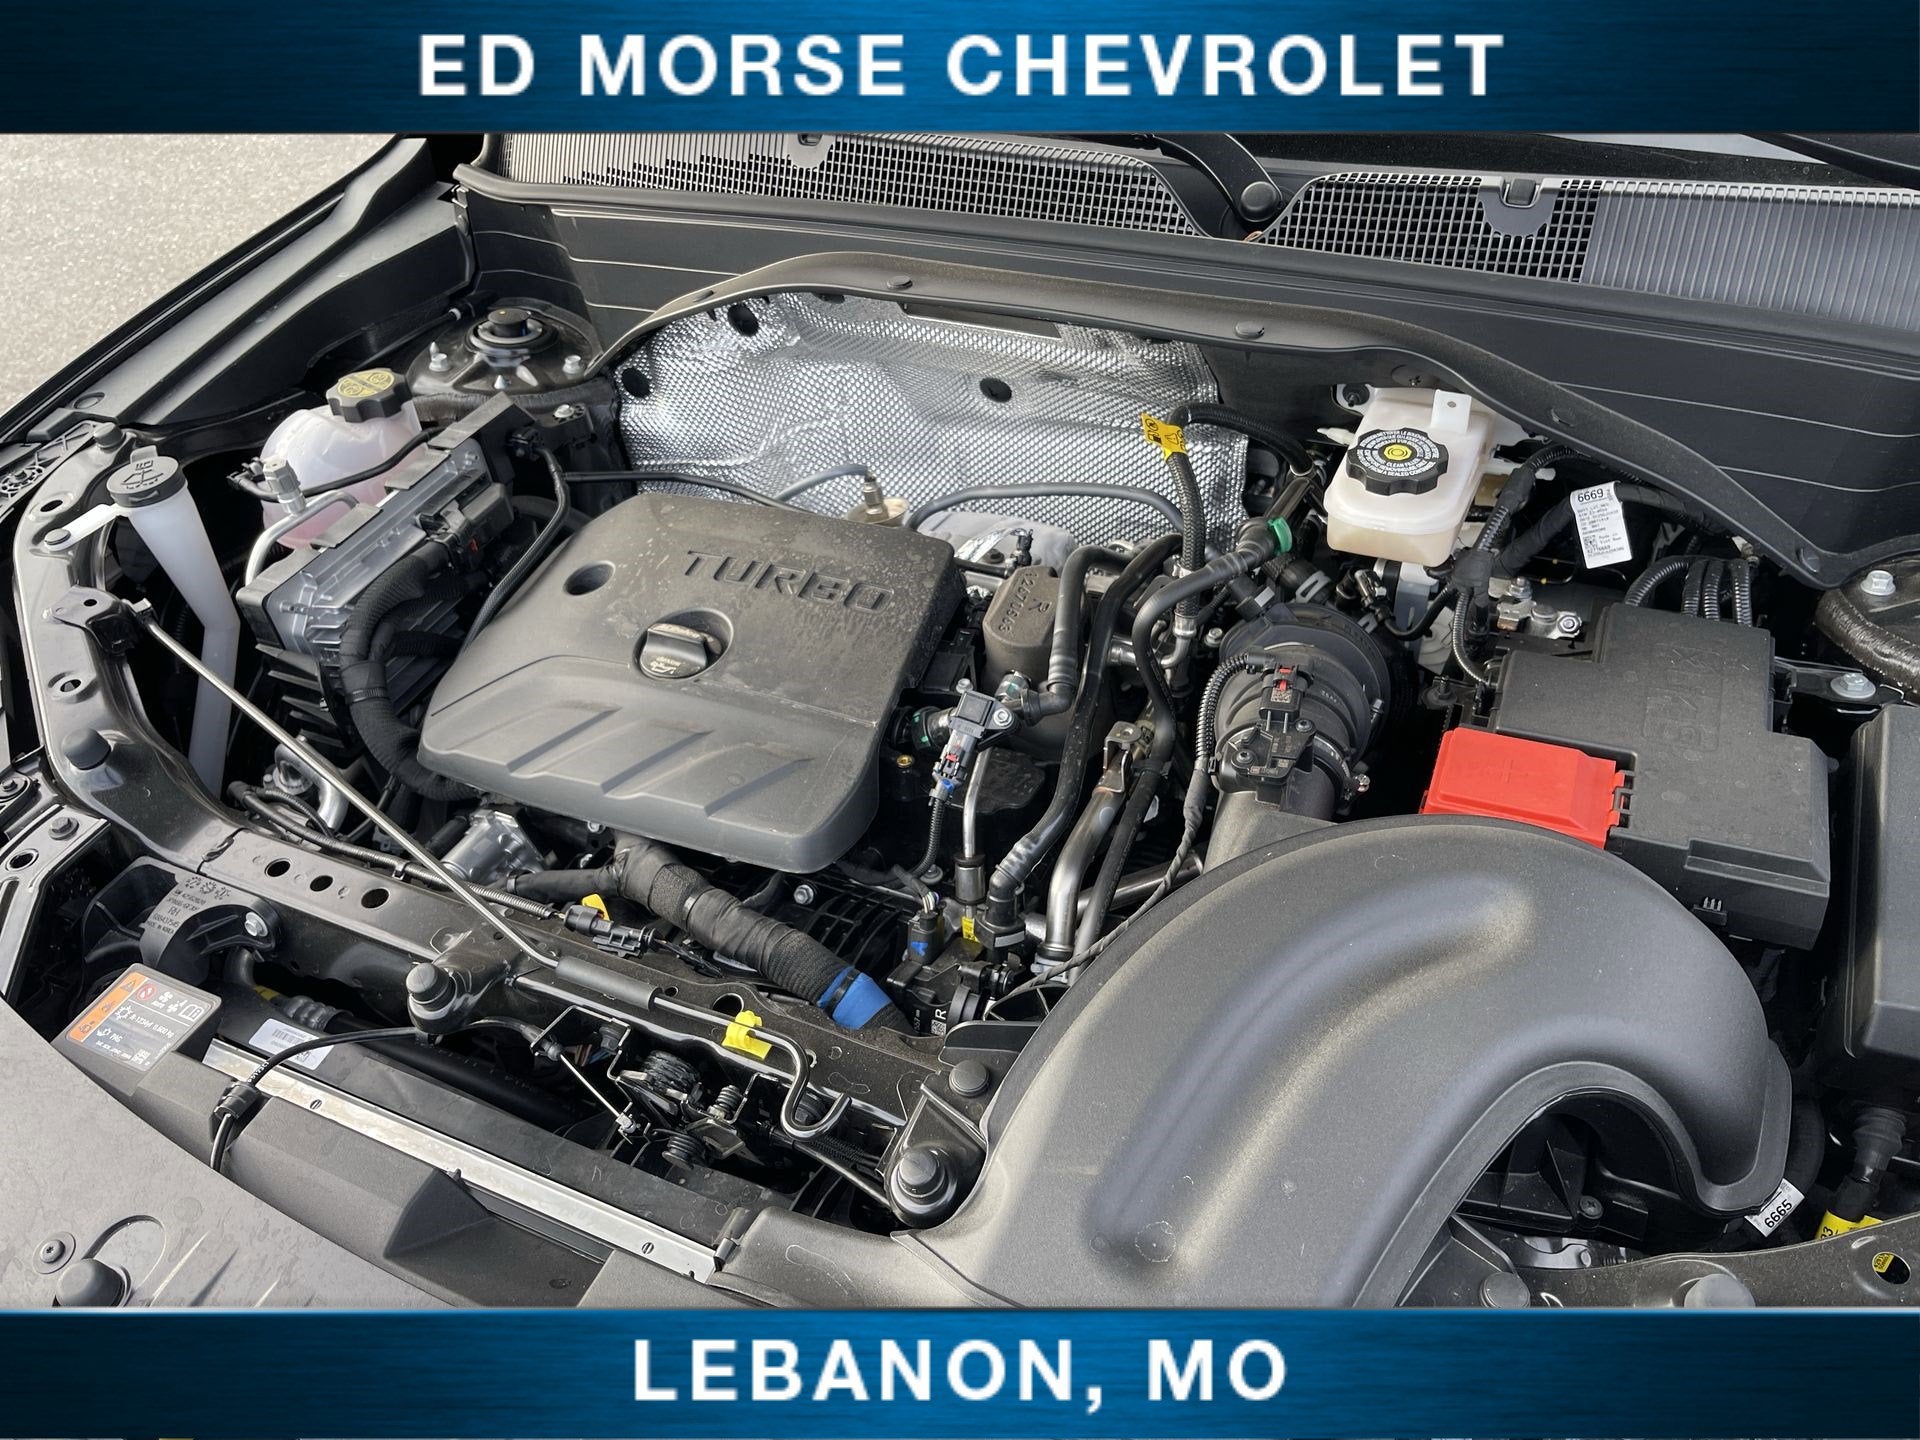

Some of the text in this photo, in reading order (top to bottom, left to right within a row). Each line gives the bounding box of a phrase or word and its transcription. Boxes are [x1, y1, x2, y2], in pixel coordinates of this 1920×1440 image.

[1577, 488, 1604, 503] 6669
[684, 550, 895, 613] TURBO
[934, 1008, 947, 1020] R
[1764, 1198, 1793, 1229] 6665
